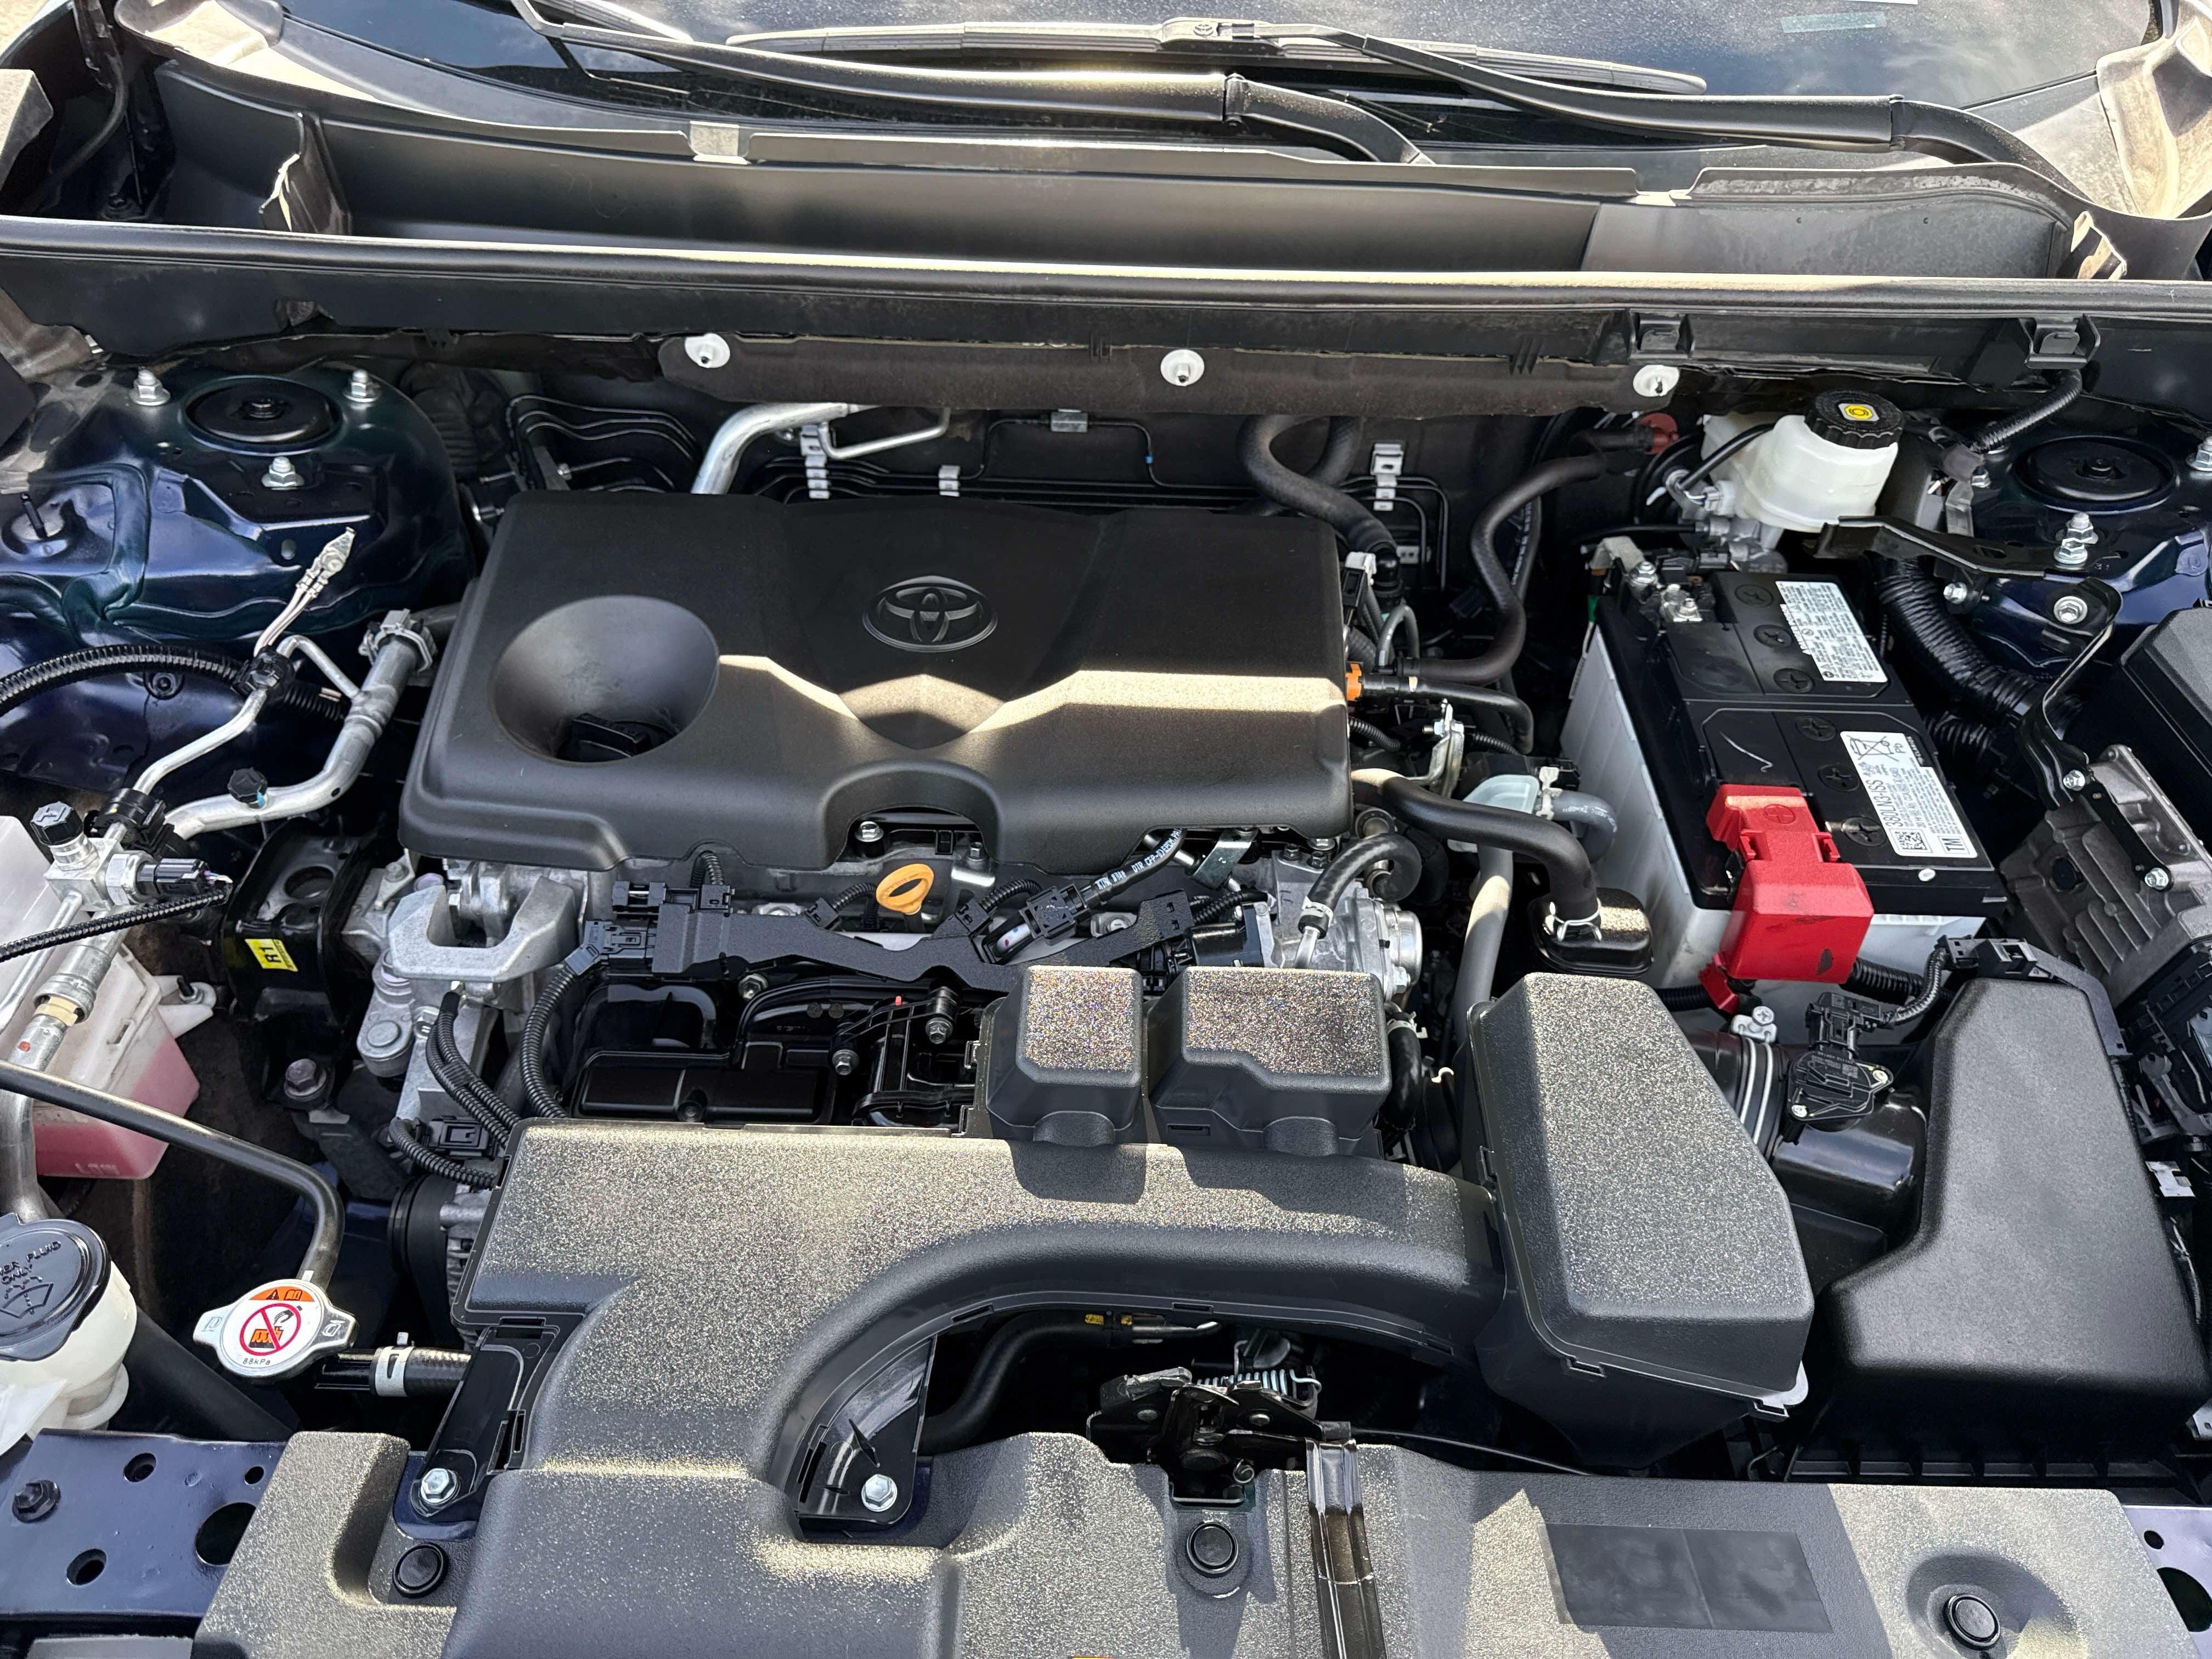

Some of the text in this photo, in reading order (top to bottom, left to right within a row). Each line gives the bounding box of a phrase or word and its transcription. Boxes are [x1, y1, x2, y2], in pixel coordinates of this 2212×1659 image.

[1893, 742, 1906, 753] Pb
[1865, 780, 1903, 827] 380LN3-ISS
[1942, 838, 1965, 851] TM
[259, 947, 281, 963] R1
[2, 1264, 32, 1284] ONLY
